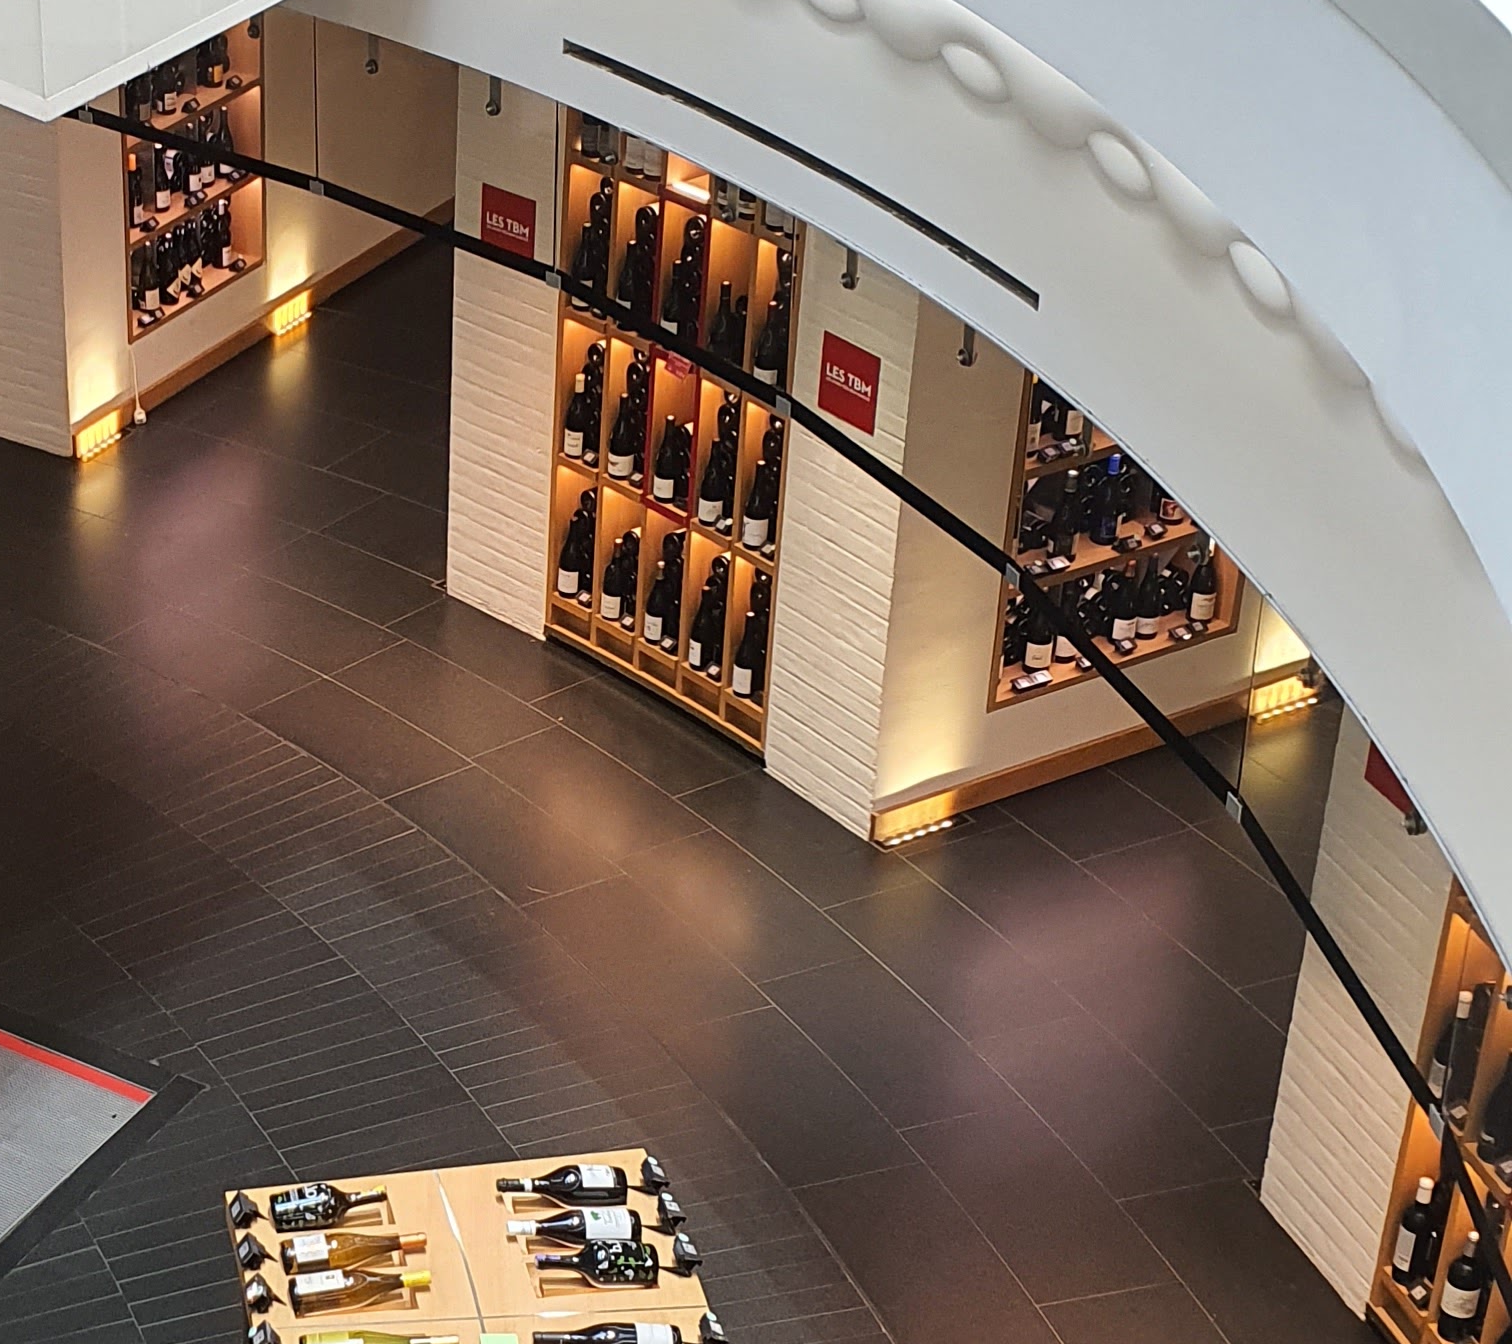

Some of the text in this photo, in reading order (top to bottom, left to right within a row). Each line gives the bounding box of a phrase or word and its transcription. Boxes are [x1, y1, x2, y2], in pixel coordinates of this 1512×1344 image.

[486, 211, 504, 228] LES
[506, 218, 530, 238] TBM
[826, 362, 846, 383] LES
[847, 373, 872, 398] TBM
